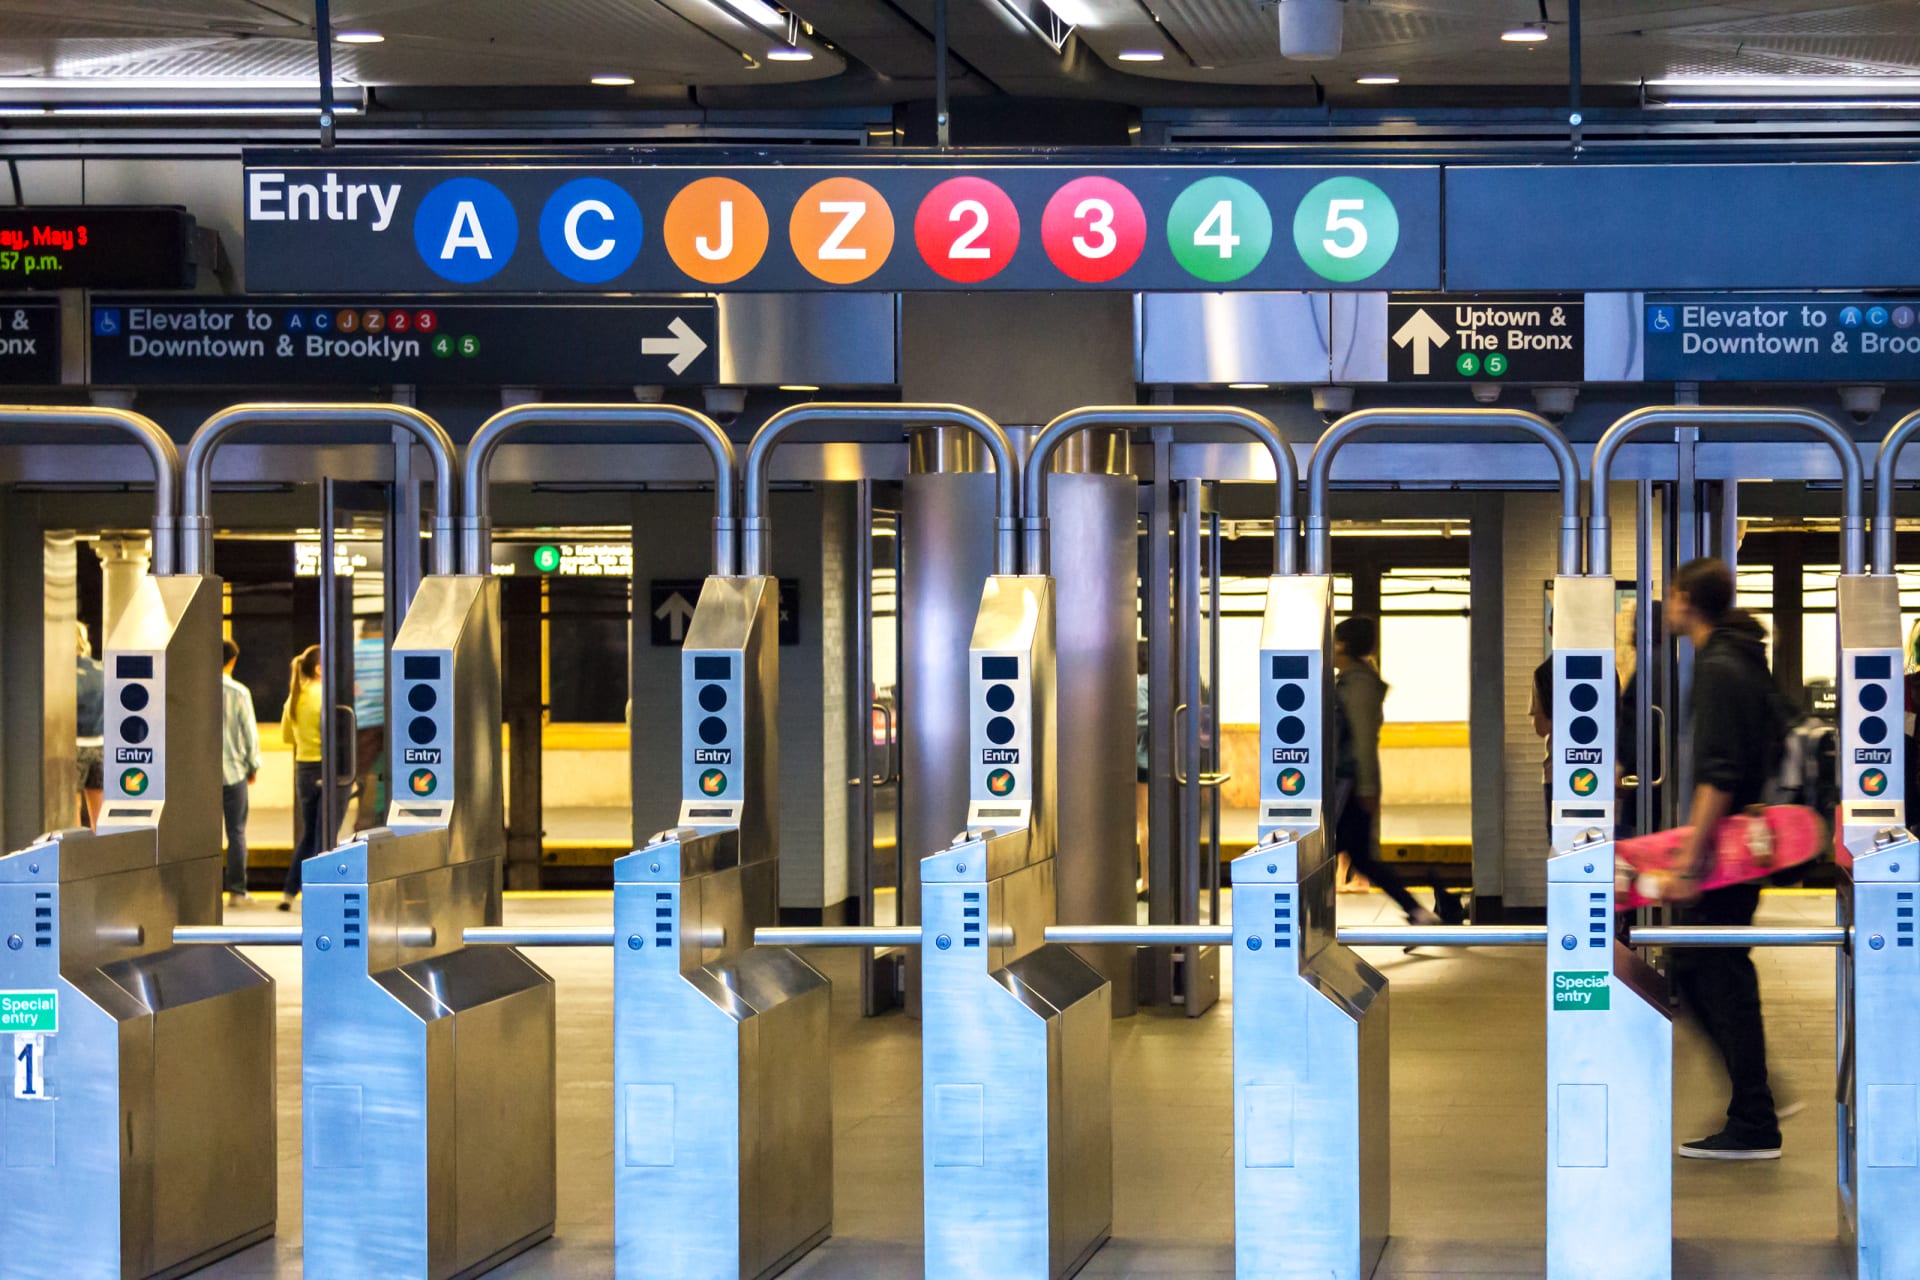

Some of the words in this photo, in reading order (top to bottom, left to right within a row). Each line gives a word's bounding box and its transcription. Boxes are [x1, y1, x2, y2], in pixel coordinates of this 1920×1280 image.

[249, 173, 401, 232] Entry
[440, 201, 493, 260] A
[564, 200, 616, 261] C
[695, 201, 733, 261] J
[818, 202, 866, 260] Z
[948, 200, 991, 259] 2
[1072, 198, 1117, 259] 3
[1194, 200, 1240, 259] 4
[1322, 199, 1368, 259] 5
[33, 225, 74, 251] May
[77, 225, 88, 246] 3
[24, 255, 63, 275] p.m.
[12, 309, 29, 331] &
[129, 308, 234, 330] Elevator
[246, 308, 272, 330] to
[290, 314, 302, 329] A
[315, 314, 328, 329] C
[343, 314, 352, 329] J
[368, 314, 380, 329] Z
[394, 314, 405, 329] 2
[420, 314, 432, 329] 3
[1455, 306, 1541, 331] Uptown
[1549, 306, 1567, 327] &
[1682, 306, 1789, 328] Elevator
[1801, 306, 1827, 328] to
[1845, 310, 1857, 325] A
[1871, 310, 1883, 325] C
[1898, 311, 1908, 325] J
[129, 335, 265, 357] Downtown
[276, 334, 294, 357] &
[306, 335, 420, 362] Brooklyn
[437, 339, 448, 353] 4
[463, 339, 474, 353] 5
[1456, 329, 1499, 350] The
[1507, 329, 1574, 350] Bronx
[1682, 332, 1820, 354] Downtown
[1830, 330, 1849, 354] &
[1861, 331, 1920, 354] Broo
[1462, 357, 1474, 371] 4
[1490, 357, 1502, 372] 5
[541, 550, 554, 567] 5
[117, 749, 152, 764] Entry
[406, 749, 440, 764] Entry
[696, 749, 730, 764] Entry
[984, 749, 1018, 764] Entry
[1274, 749, 1308, 763] Entry
[1566, 749, 1601, 764] Entry
[1856, 749, 1891, 764] Entry
[1555, 975, 1609, 990] Special
[2, 997, 54, 1014] Special
[1556, 990, 1592, 1005] entry
[2, 1012, 38, 1027] entry
[17, 1043, 37, 1095] 1
